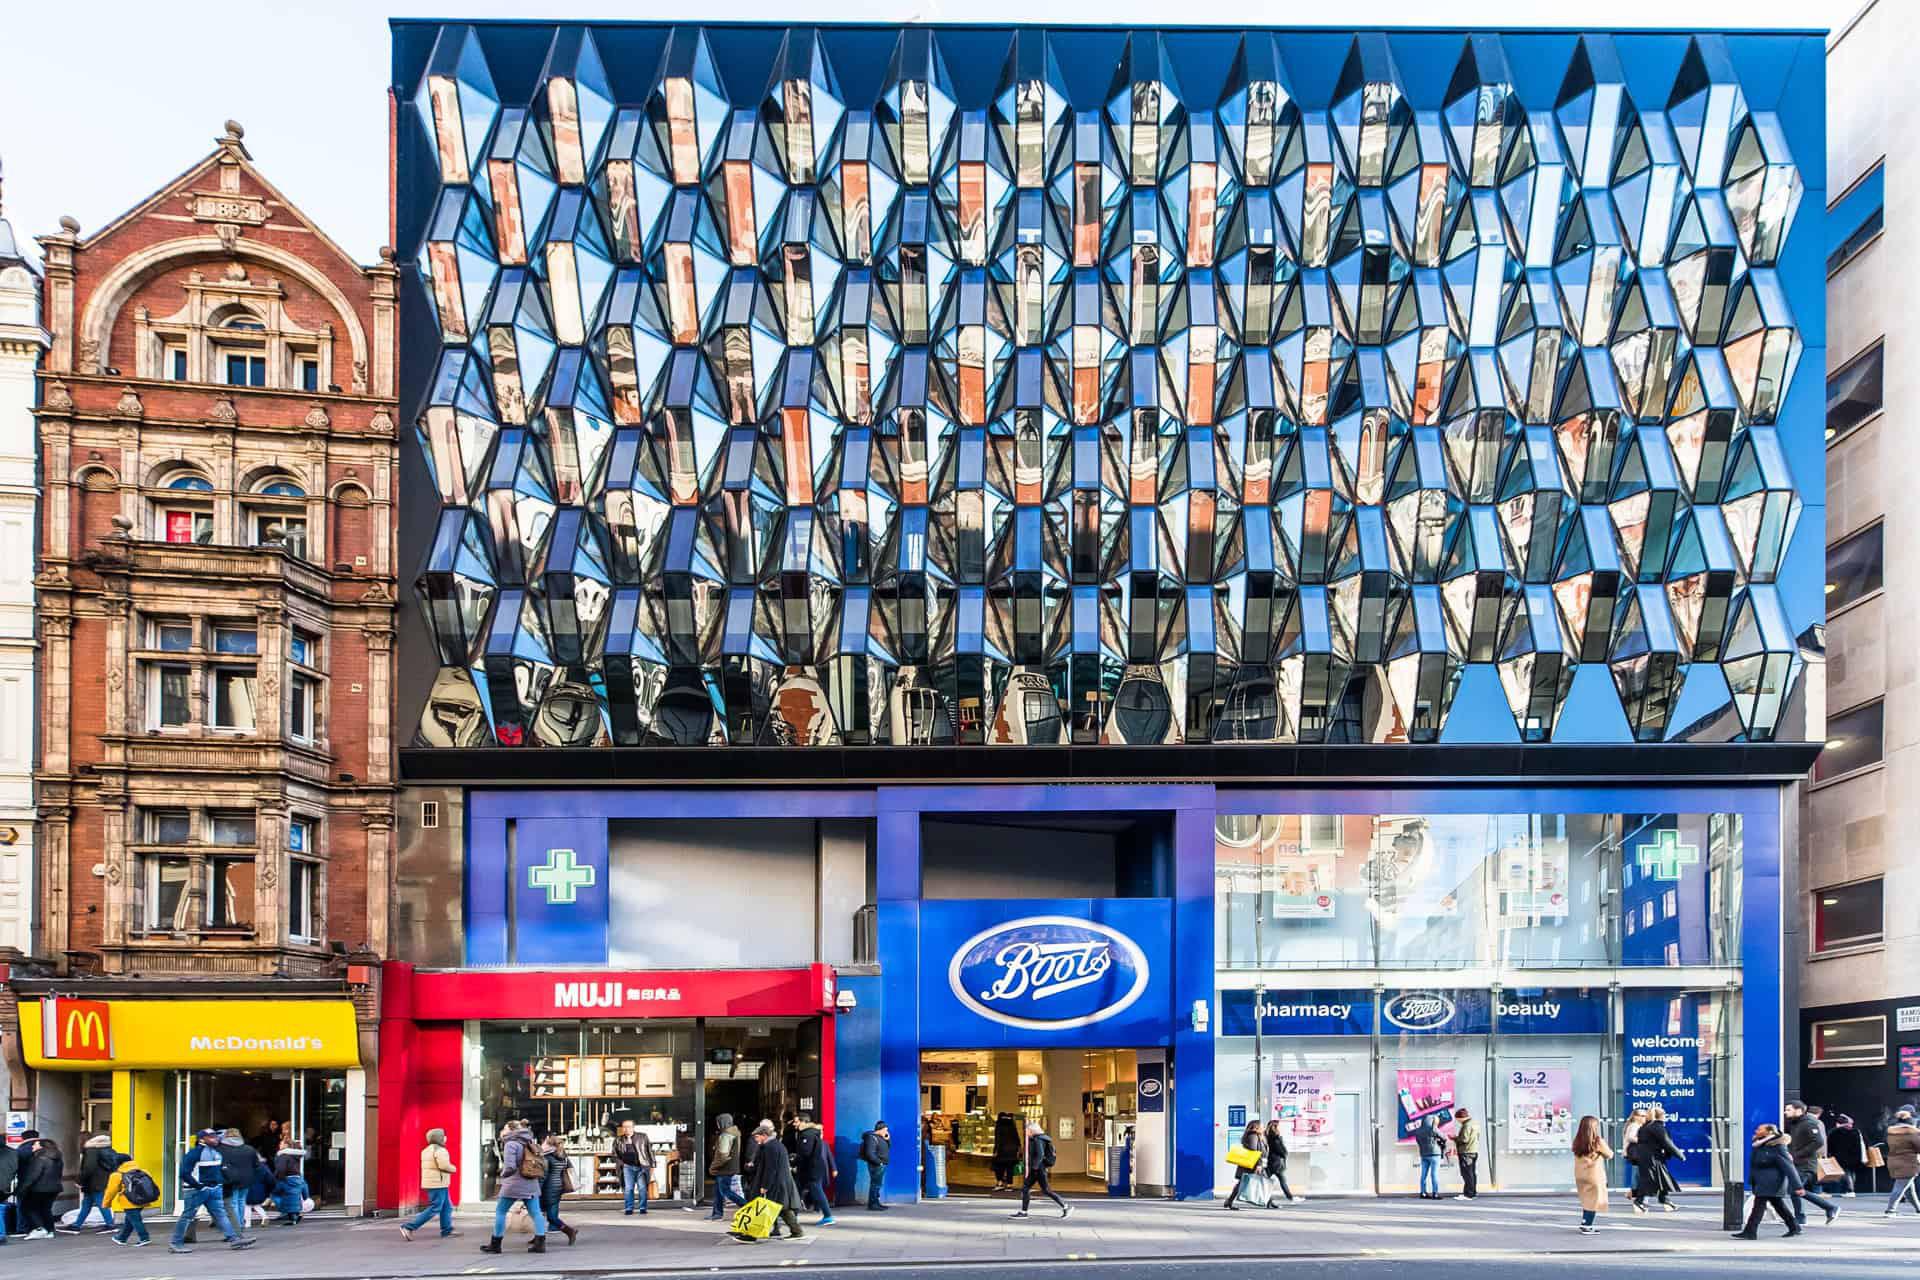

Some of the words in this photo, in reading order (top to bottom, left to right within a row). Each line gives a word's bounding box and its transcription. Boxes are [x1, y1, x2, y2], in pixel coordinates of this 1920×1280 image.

[981, 941, 1111, 1001] Boots
[555, 983, 622, 1008] MUJI
[1254, 1002, 1352, 1020] pharmacy
[1397, 1001, 1443, 1020] Boots
[1496, 1001, 1561, 1018] beauty
[190, 1036, 322, 1050] McDonald's
[1632, 1035, 1705, 1048] welcome
[1632, 1066, 1666, 1074] beauty
[1513, 1071, 1523, 1084] 3
[1536, 1071, 1546, 1084] 2
[1632, 1077, 1656, 1086] food
[1668, 1077, 1695, 1086] drink
[1275, 1082, 1298, 1094] 1/2
[1298, 1088, 1320, 1096] price
[1632, 1089, 1657, 1098] baby
[1660, 1089, 1667, 1097] &
[1670, 1089, 1695, 1097] child
[1632, 1101, 1662, 1110] photo
